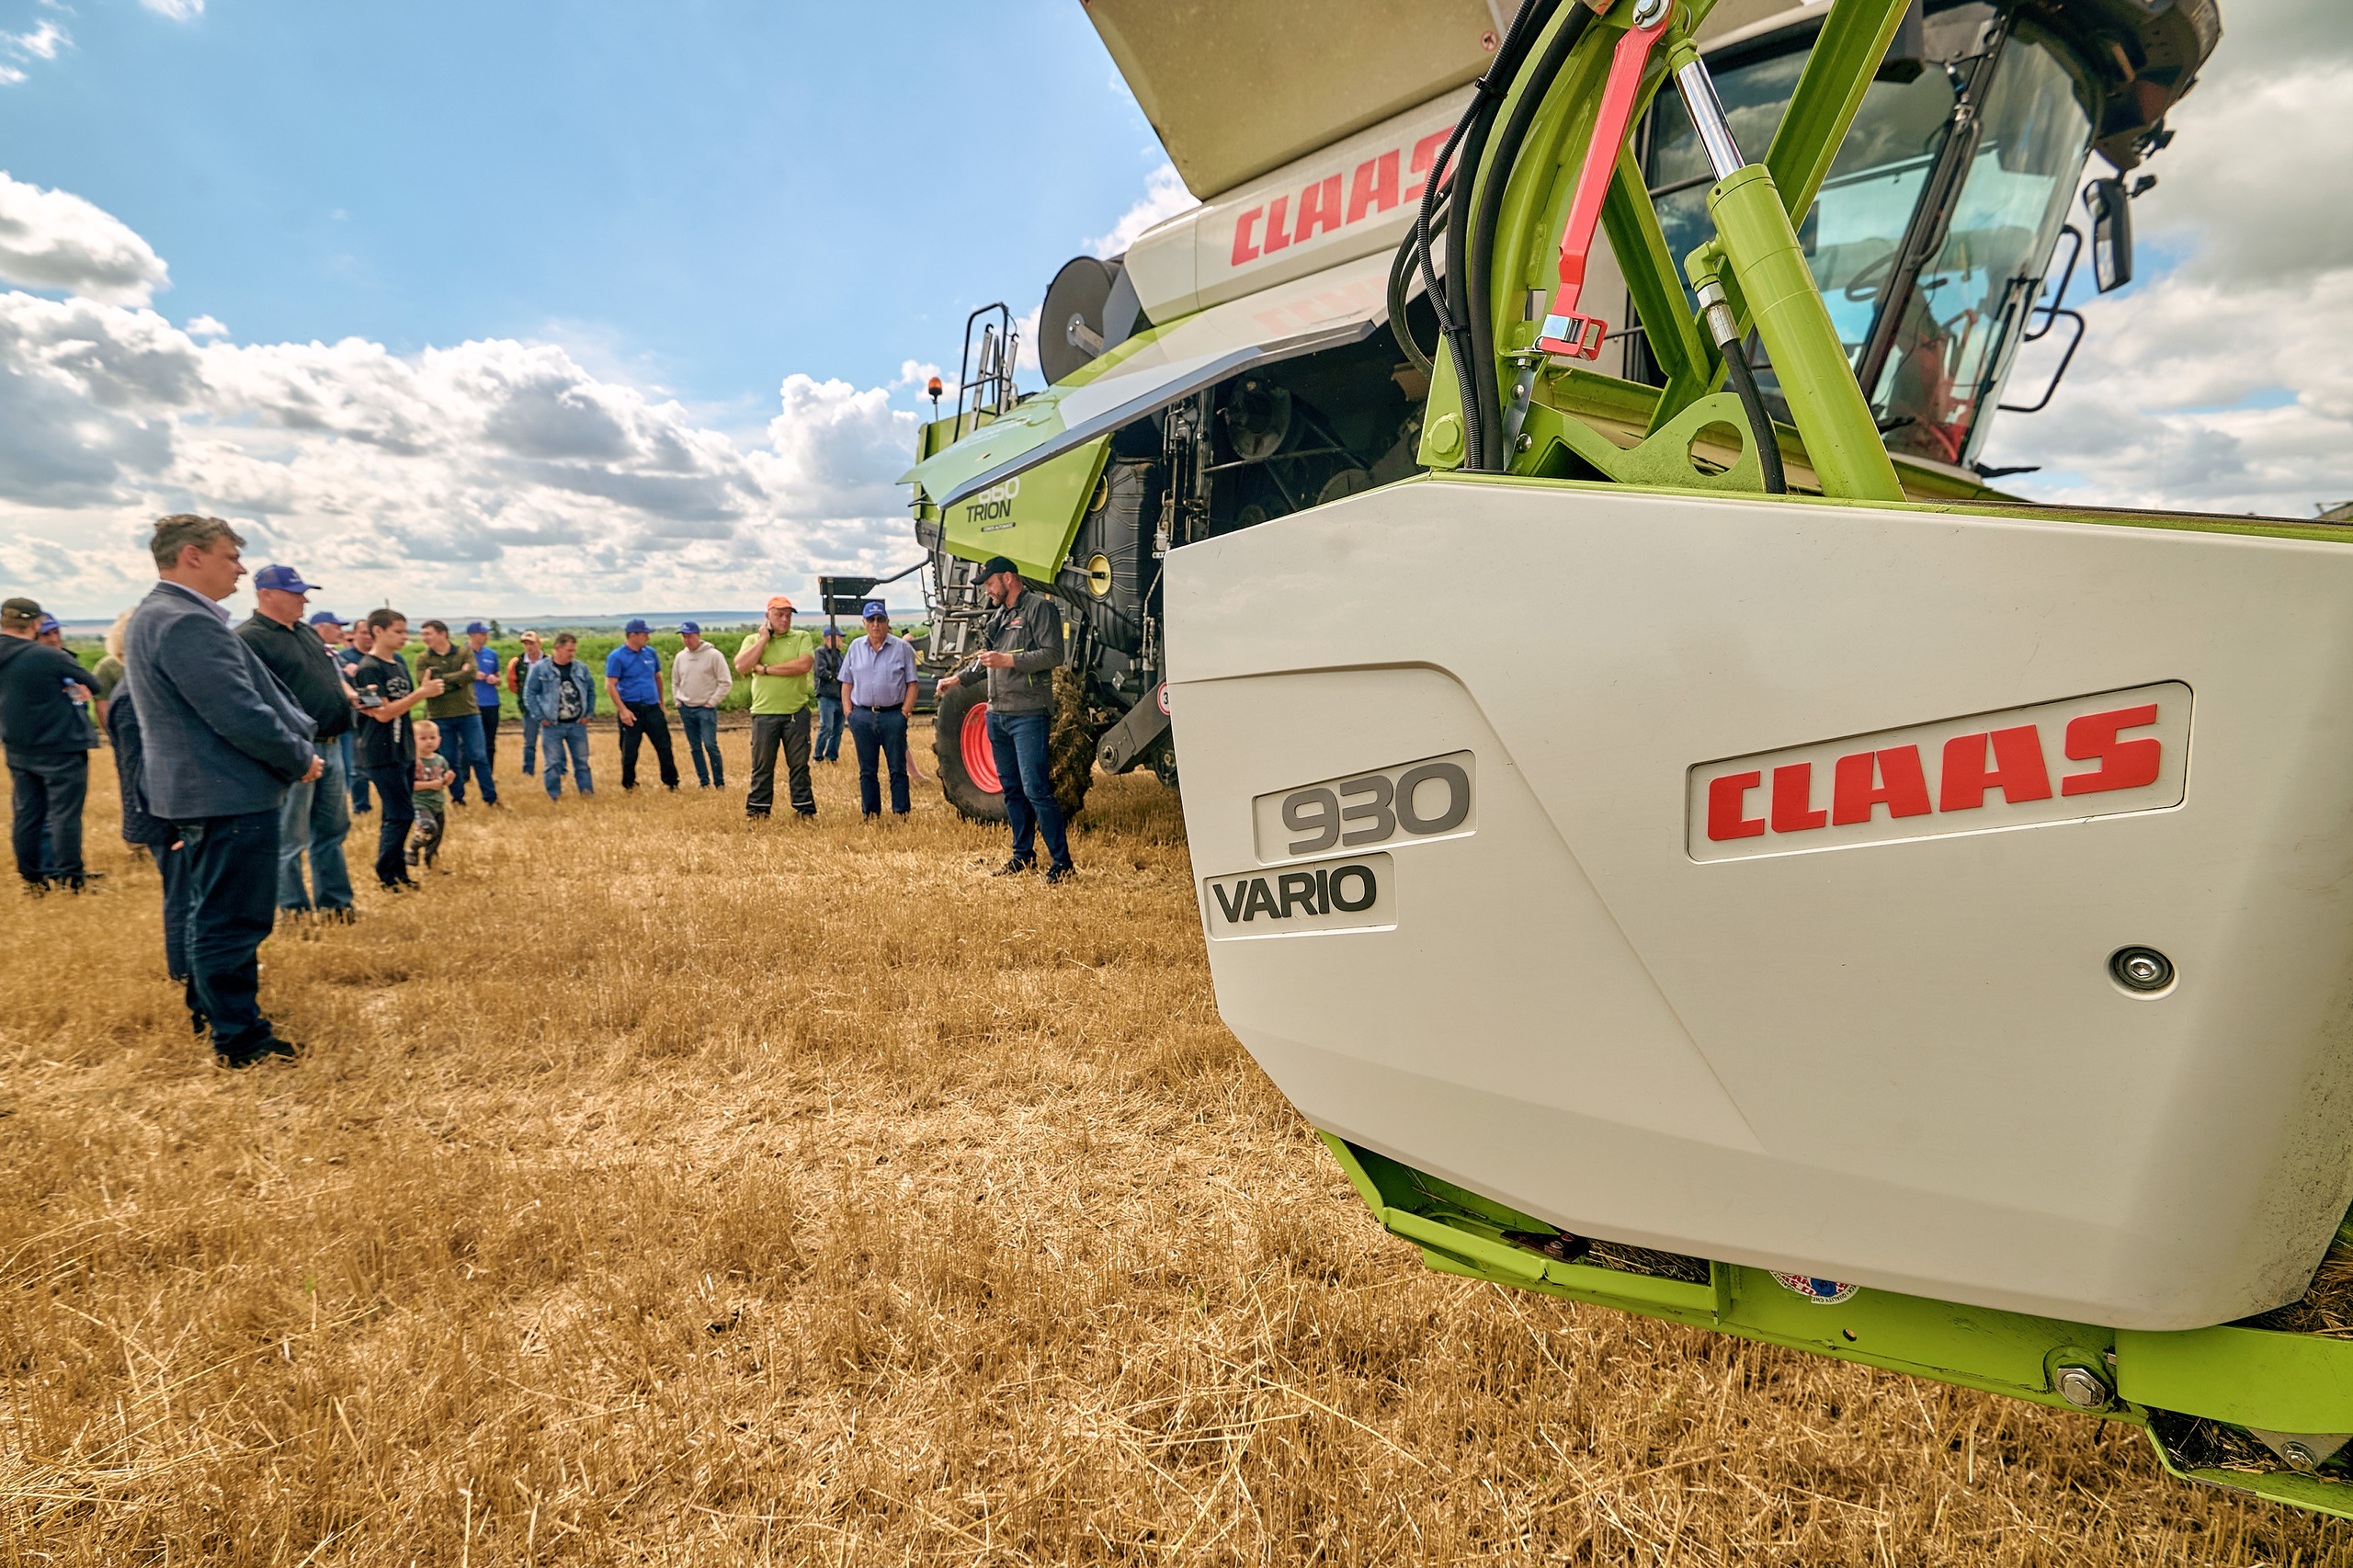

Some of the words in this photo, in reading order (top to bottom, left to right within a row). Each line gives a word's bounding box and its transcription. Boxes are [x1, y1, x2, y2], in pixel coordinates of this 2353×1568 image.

[1231, 125, 1456, 267] CLAAS
[966, 498, 1011, 523] TRION
[1281, 762, 1470, 855] 930
[1707, 703, 2161, 842] CLAAS
[1211, 864, 1377, 923] VARIO
